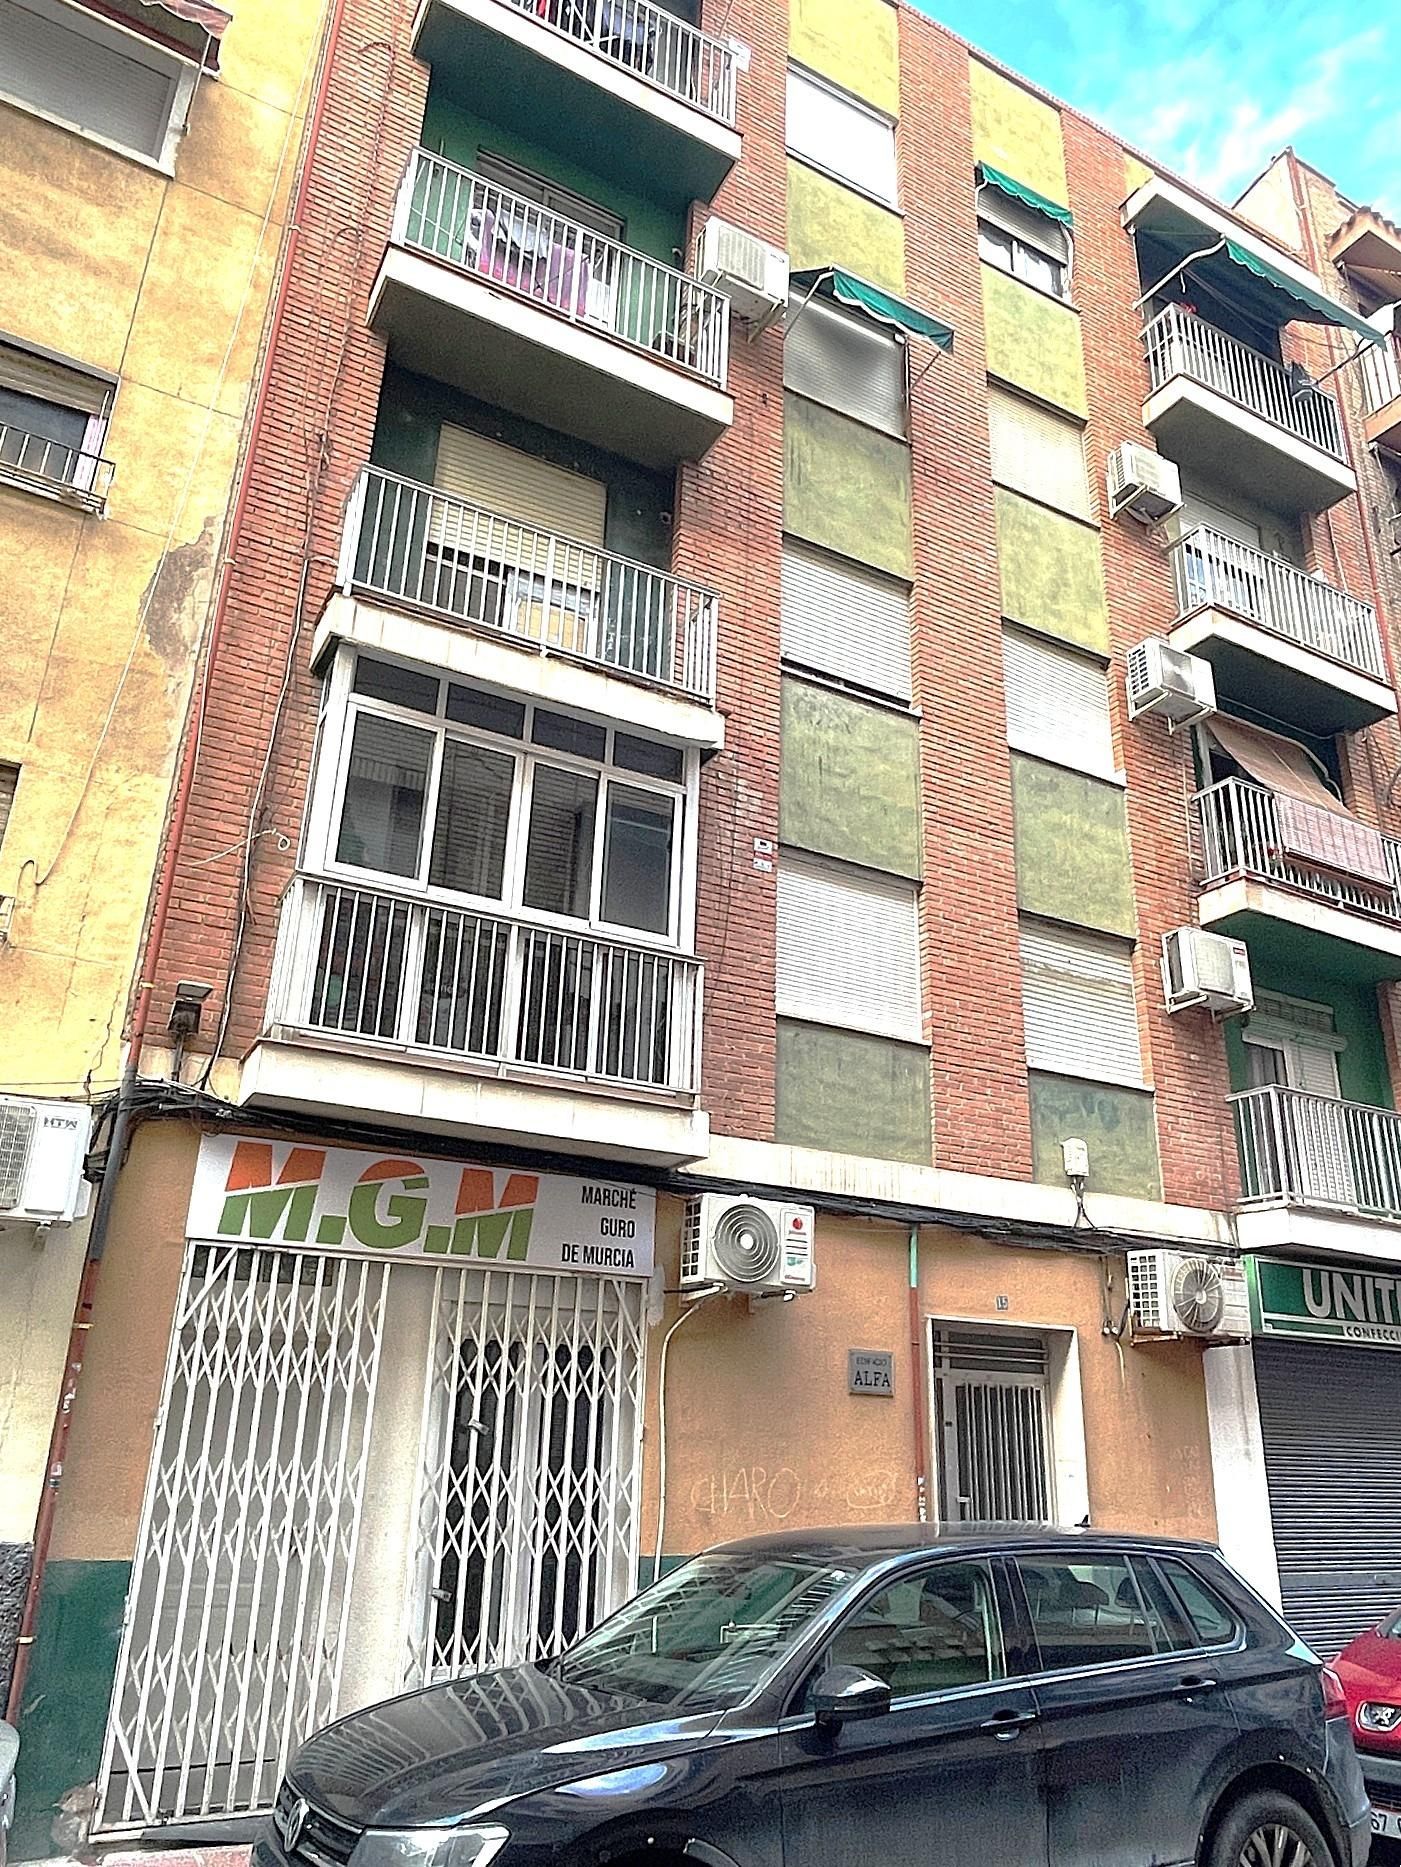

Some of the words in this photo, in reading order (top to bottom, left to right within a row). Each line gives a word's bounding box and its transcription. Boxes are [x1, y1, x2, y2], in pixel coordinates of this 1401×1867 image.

[217, 1140, 539, 1261] M.G.M
[581, 1186, 637, 1209] MARCHÉ
[600, 1217, 636, 1238] GURO
[561, 1243, 580, 1263] DE
[583, 1245, 635, 1268] MURCIA
[854, 1370, 891, 1387] ALFA
